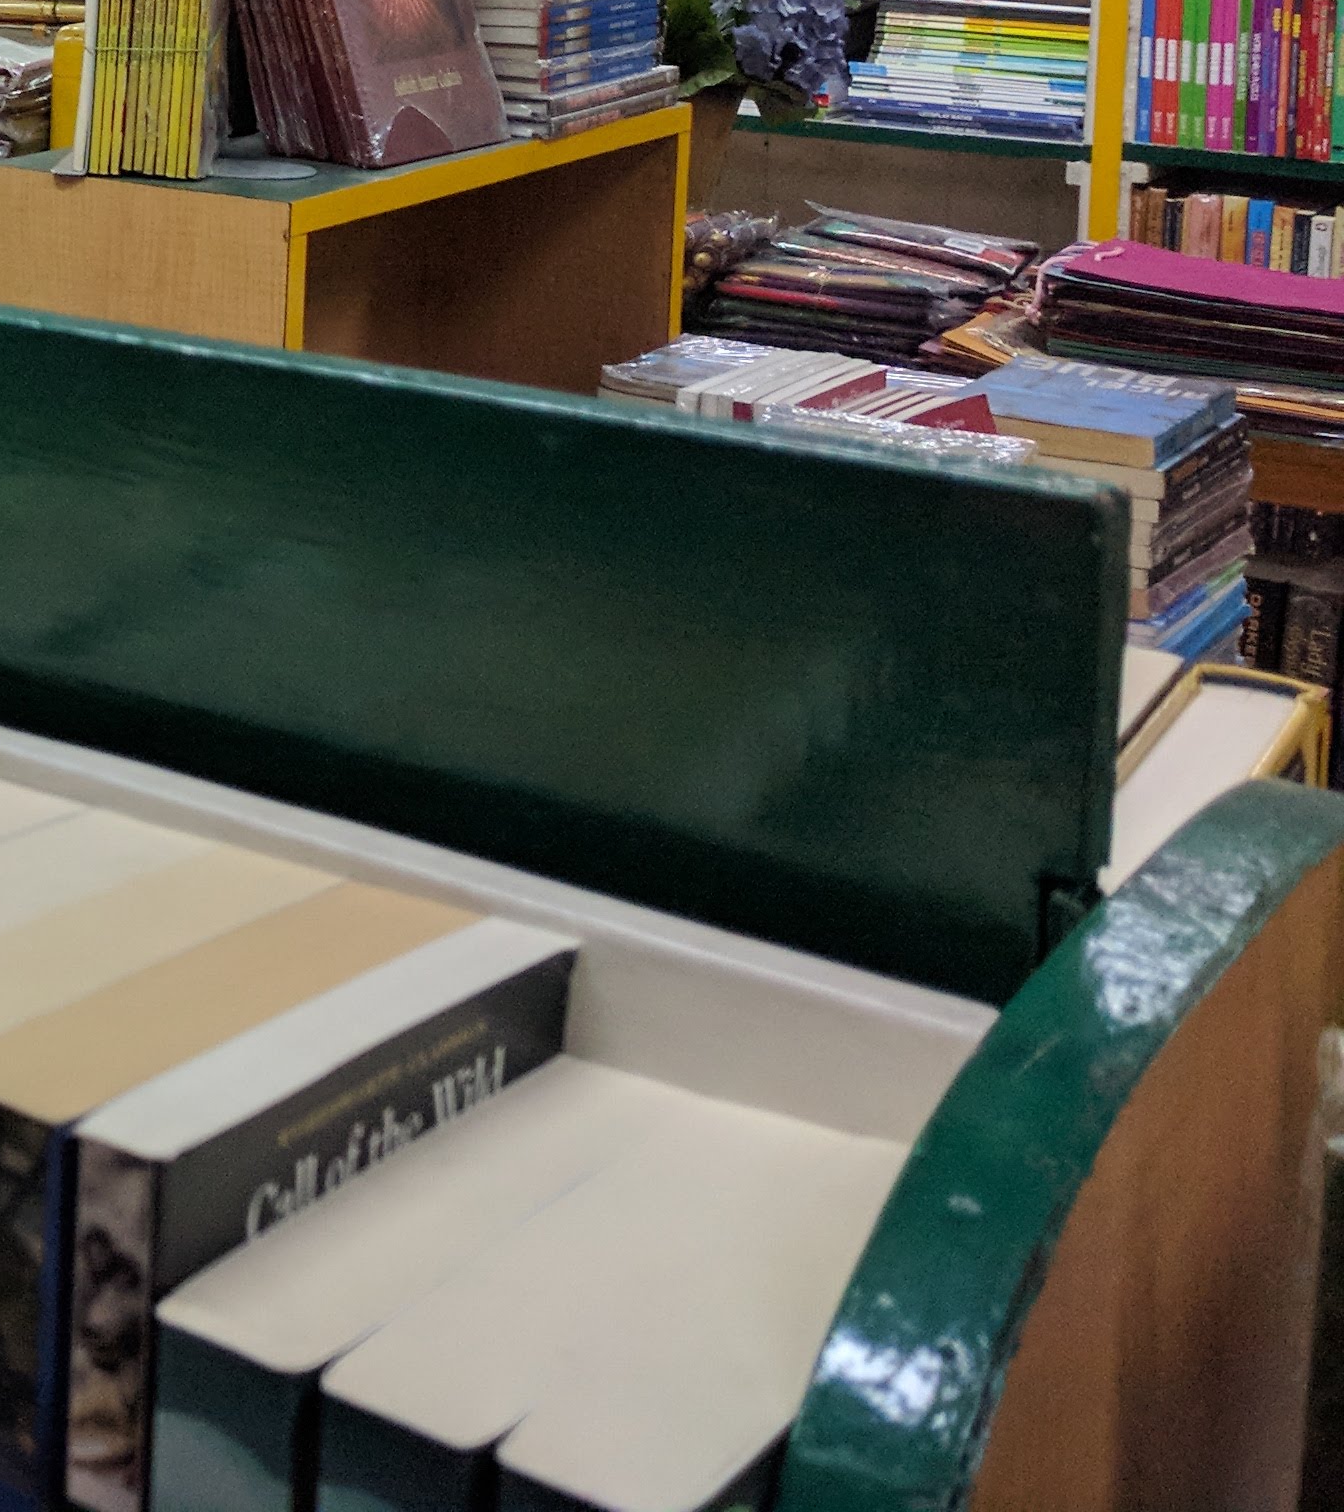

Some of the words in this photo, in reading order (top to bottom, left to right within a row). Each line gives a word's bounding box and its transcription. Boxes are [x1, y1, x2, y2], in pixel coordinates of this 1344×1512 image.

[244, 1153, 319, 1242] Call
[324, 1126, 366, 1195] of
[367, 1106, 426, 1162] the
[432, 1044, 510, 1130] Wild
